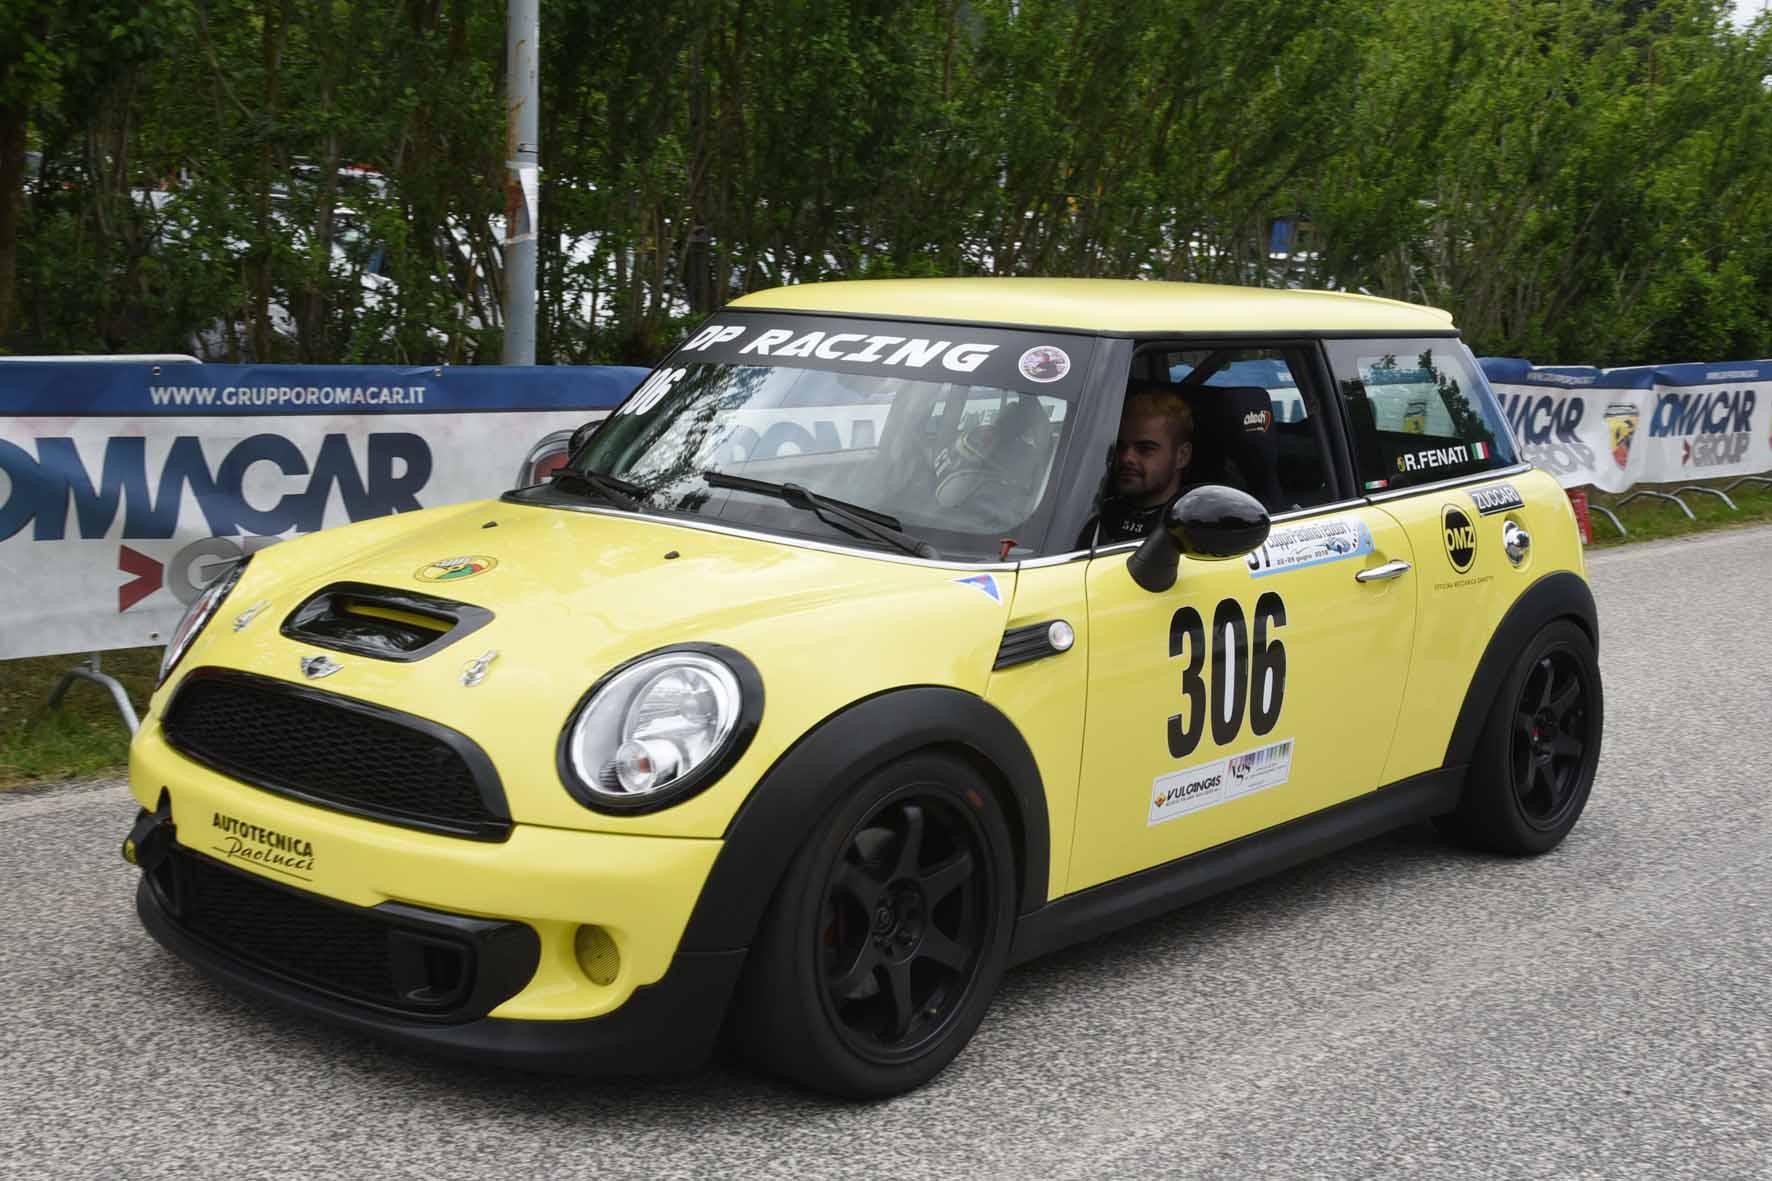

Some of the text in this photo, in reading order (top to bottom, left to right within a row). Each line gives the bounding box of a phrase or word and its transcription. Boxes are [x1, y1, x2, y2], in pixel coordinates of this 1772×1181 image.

[681, 325, 999, 372] DP RACING
[150, 386, 426, 406] WWW.GRUPPOROMACAR.IT
[614, 367, 687, 416] 06
[1404, 446, 1468, 471] R.FENATI
[1476, 486, 1520, 510] ZUCCARI
[1445, 527, 1474, 551] OMZ
[1167, 591, 1287, 759] 306
[212, 812, 313, 857] AUTOTECNICA
[224, 836, 315, 870] Paolucci
